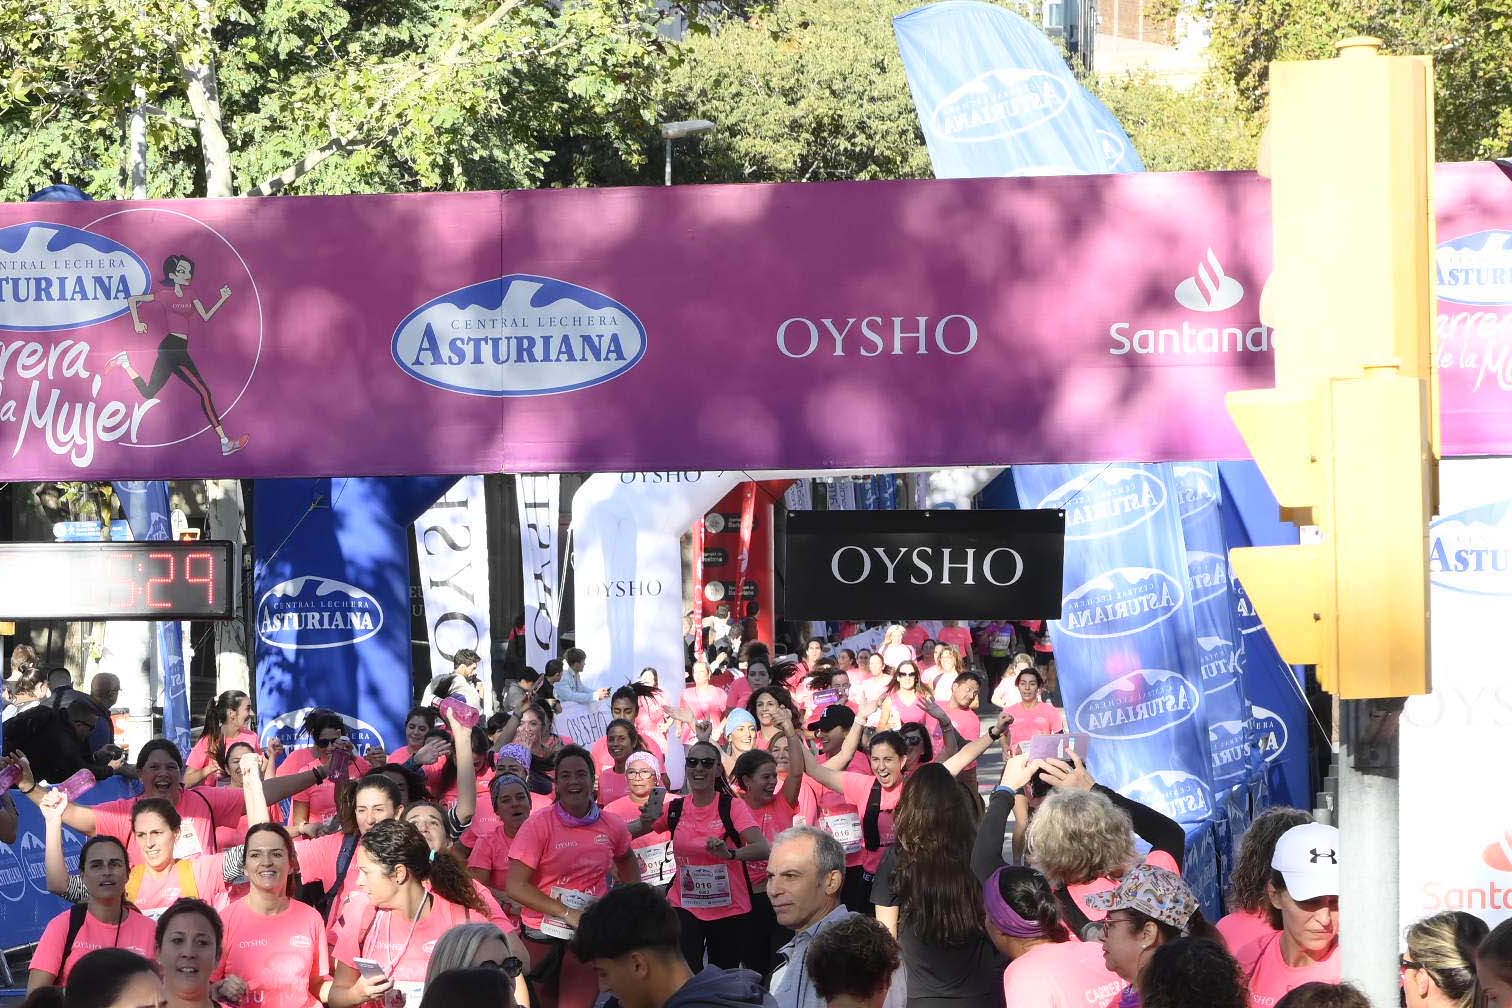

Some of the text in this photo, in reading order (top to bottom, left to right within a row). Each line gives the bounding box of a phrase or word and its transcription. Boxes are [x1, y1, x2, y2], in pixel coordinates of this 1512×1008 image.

[53, 258, 126, 270] LECHERA
[451, 315, 618, 330] CENTRAL LECHERA
[775, 314, 979, 359] OYSHO
[411, 322, 626, 366] ASTURIANA
[12, 375, 162, 468] Mujer
[831, 545, 1024, 587] OYSHO
[1429, 536, 1512, 573] ASTU
[261, 607, 374, 633] ASTURIANA
[273, 600, 369, 609] CENTRAL LECHERA
